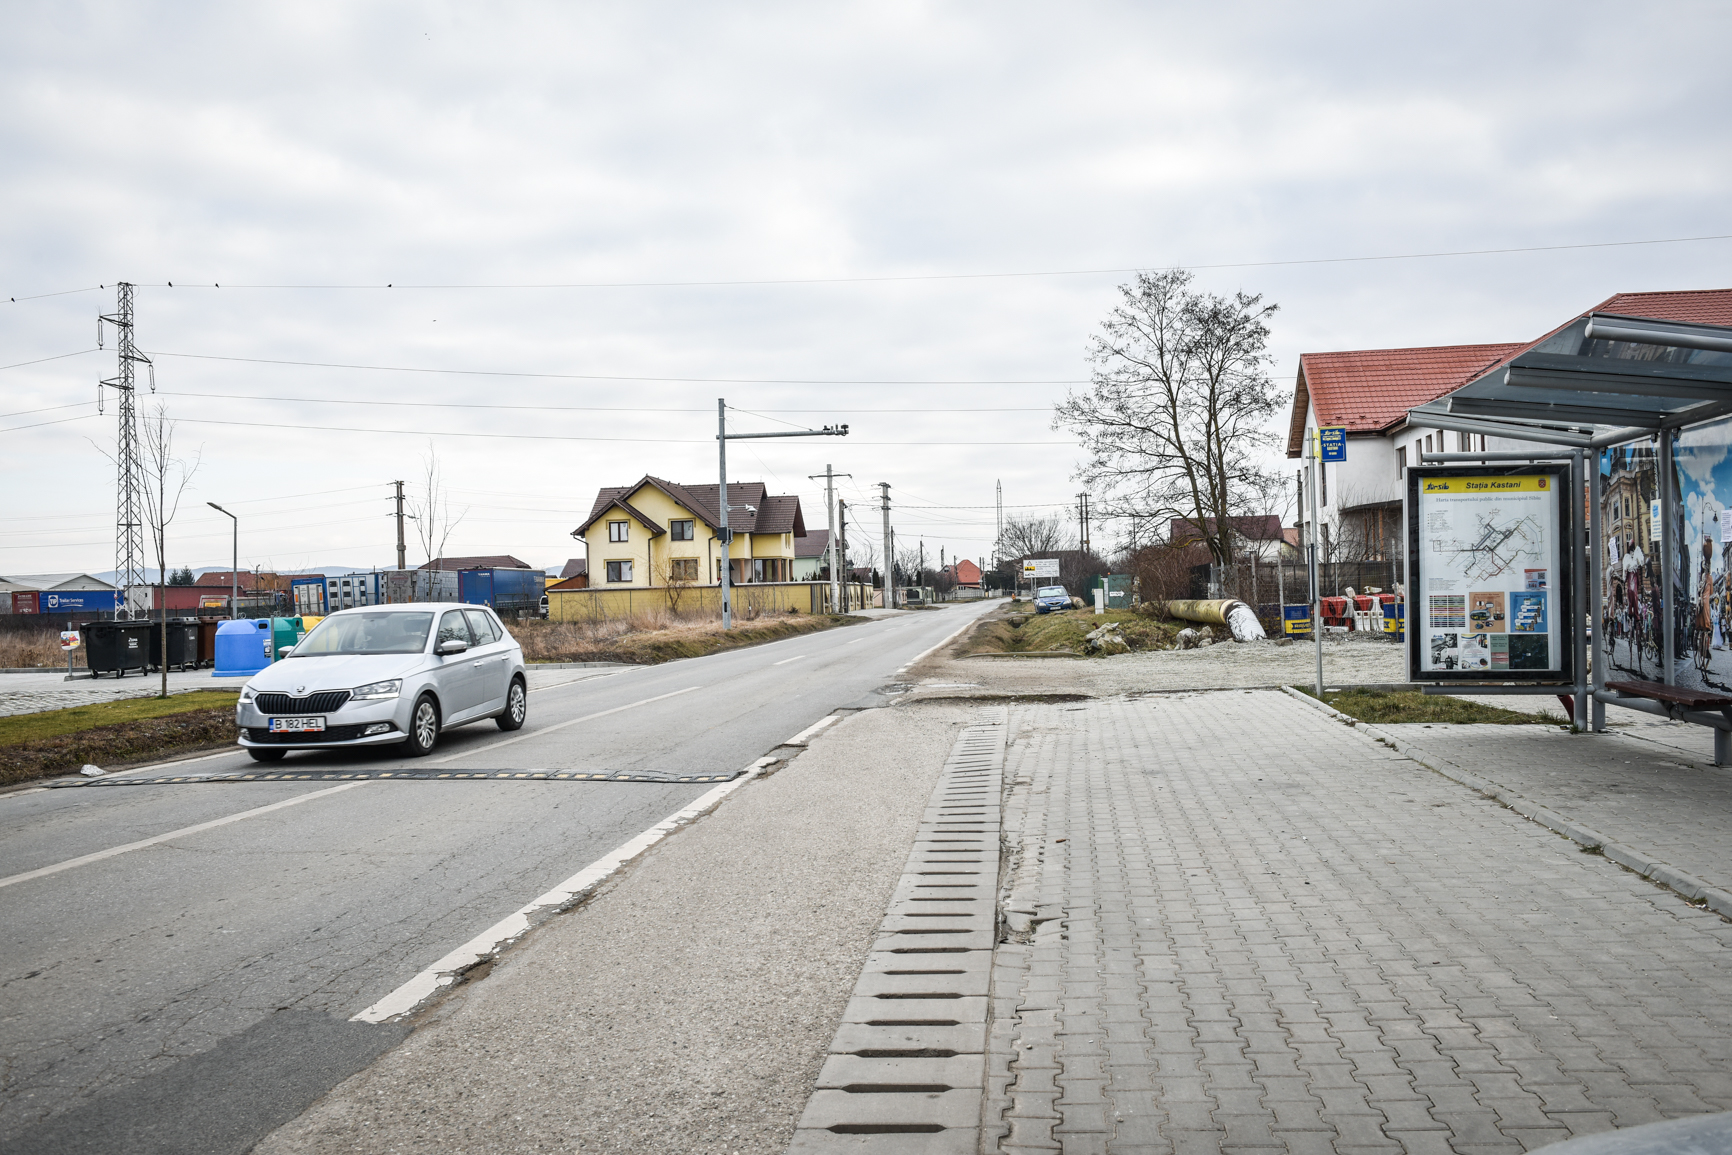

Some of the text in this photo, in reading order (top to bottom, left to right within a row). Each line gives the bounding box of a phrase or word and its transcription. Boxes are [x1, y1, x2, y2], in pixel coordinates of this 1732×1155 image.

[1466, 481, 1521, 491] Stația Kastani
[275, 718, 322, 729] B 182 HEL
